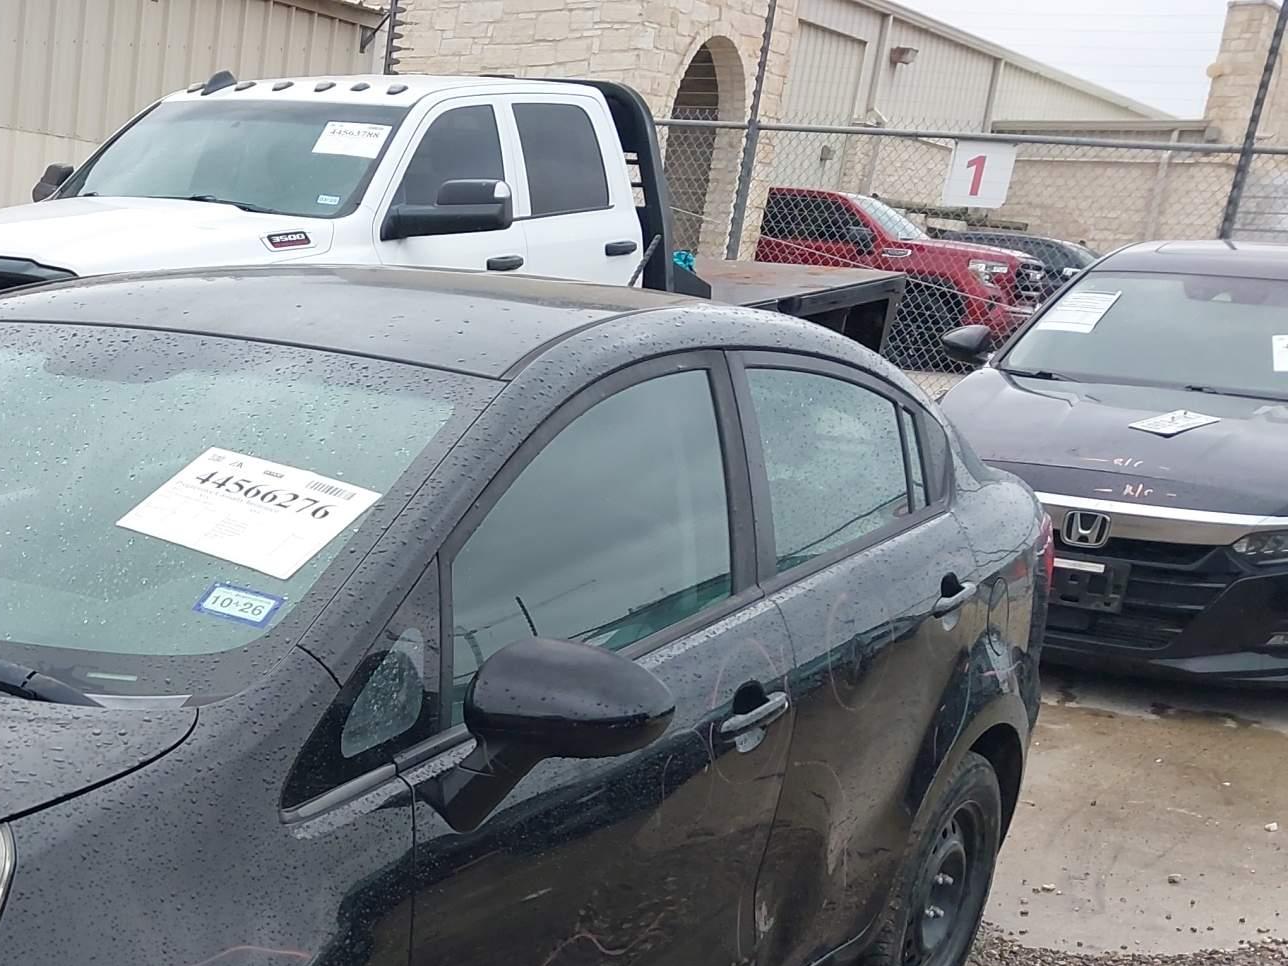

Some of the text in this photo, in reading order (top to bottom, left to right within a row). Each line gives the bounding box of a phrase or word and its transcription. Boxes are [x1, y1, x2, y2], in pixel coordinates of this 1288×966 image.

[966, 155, 987, 196] 1
[271, 233, 306, 242] 3500
[196, 470, 336, 520] 44566276
